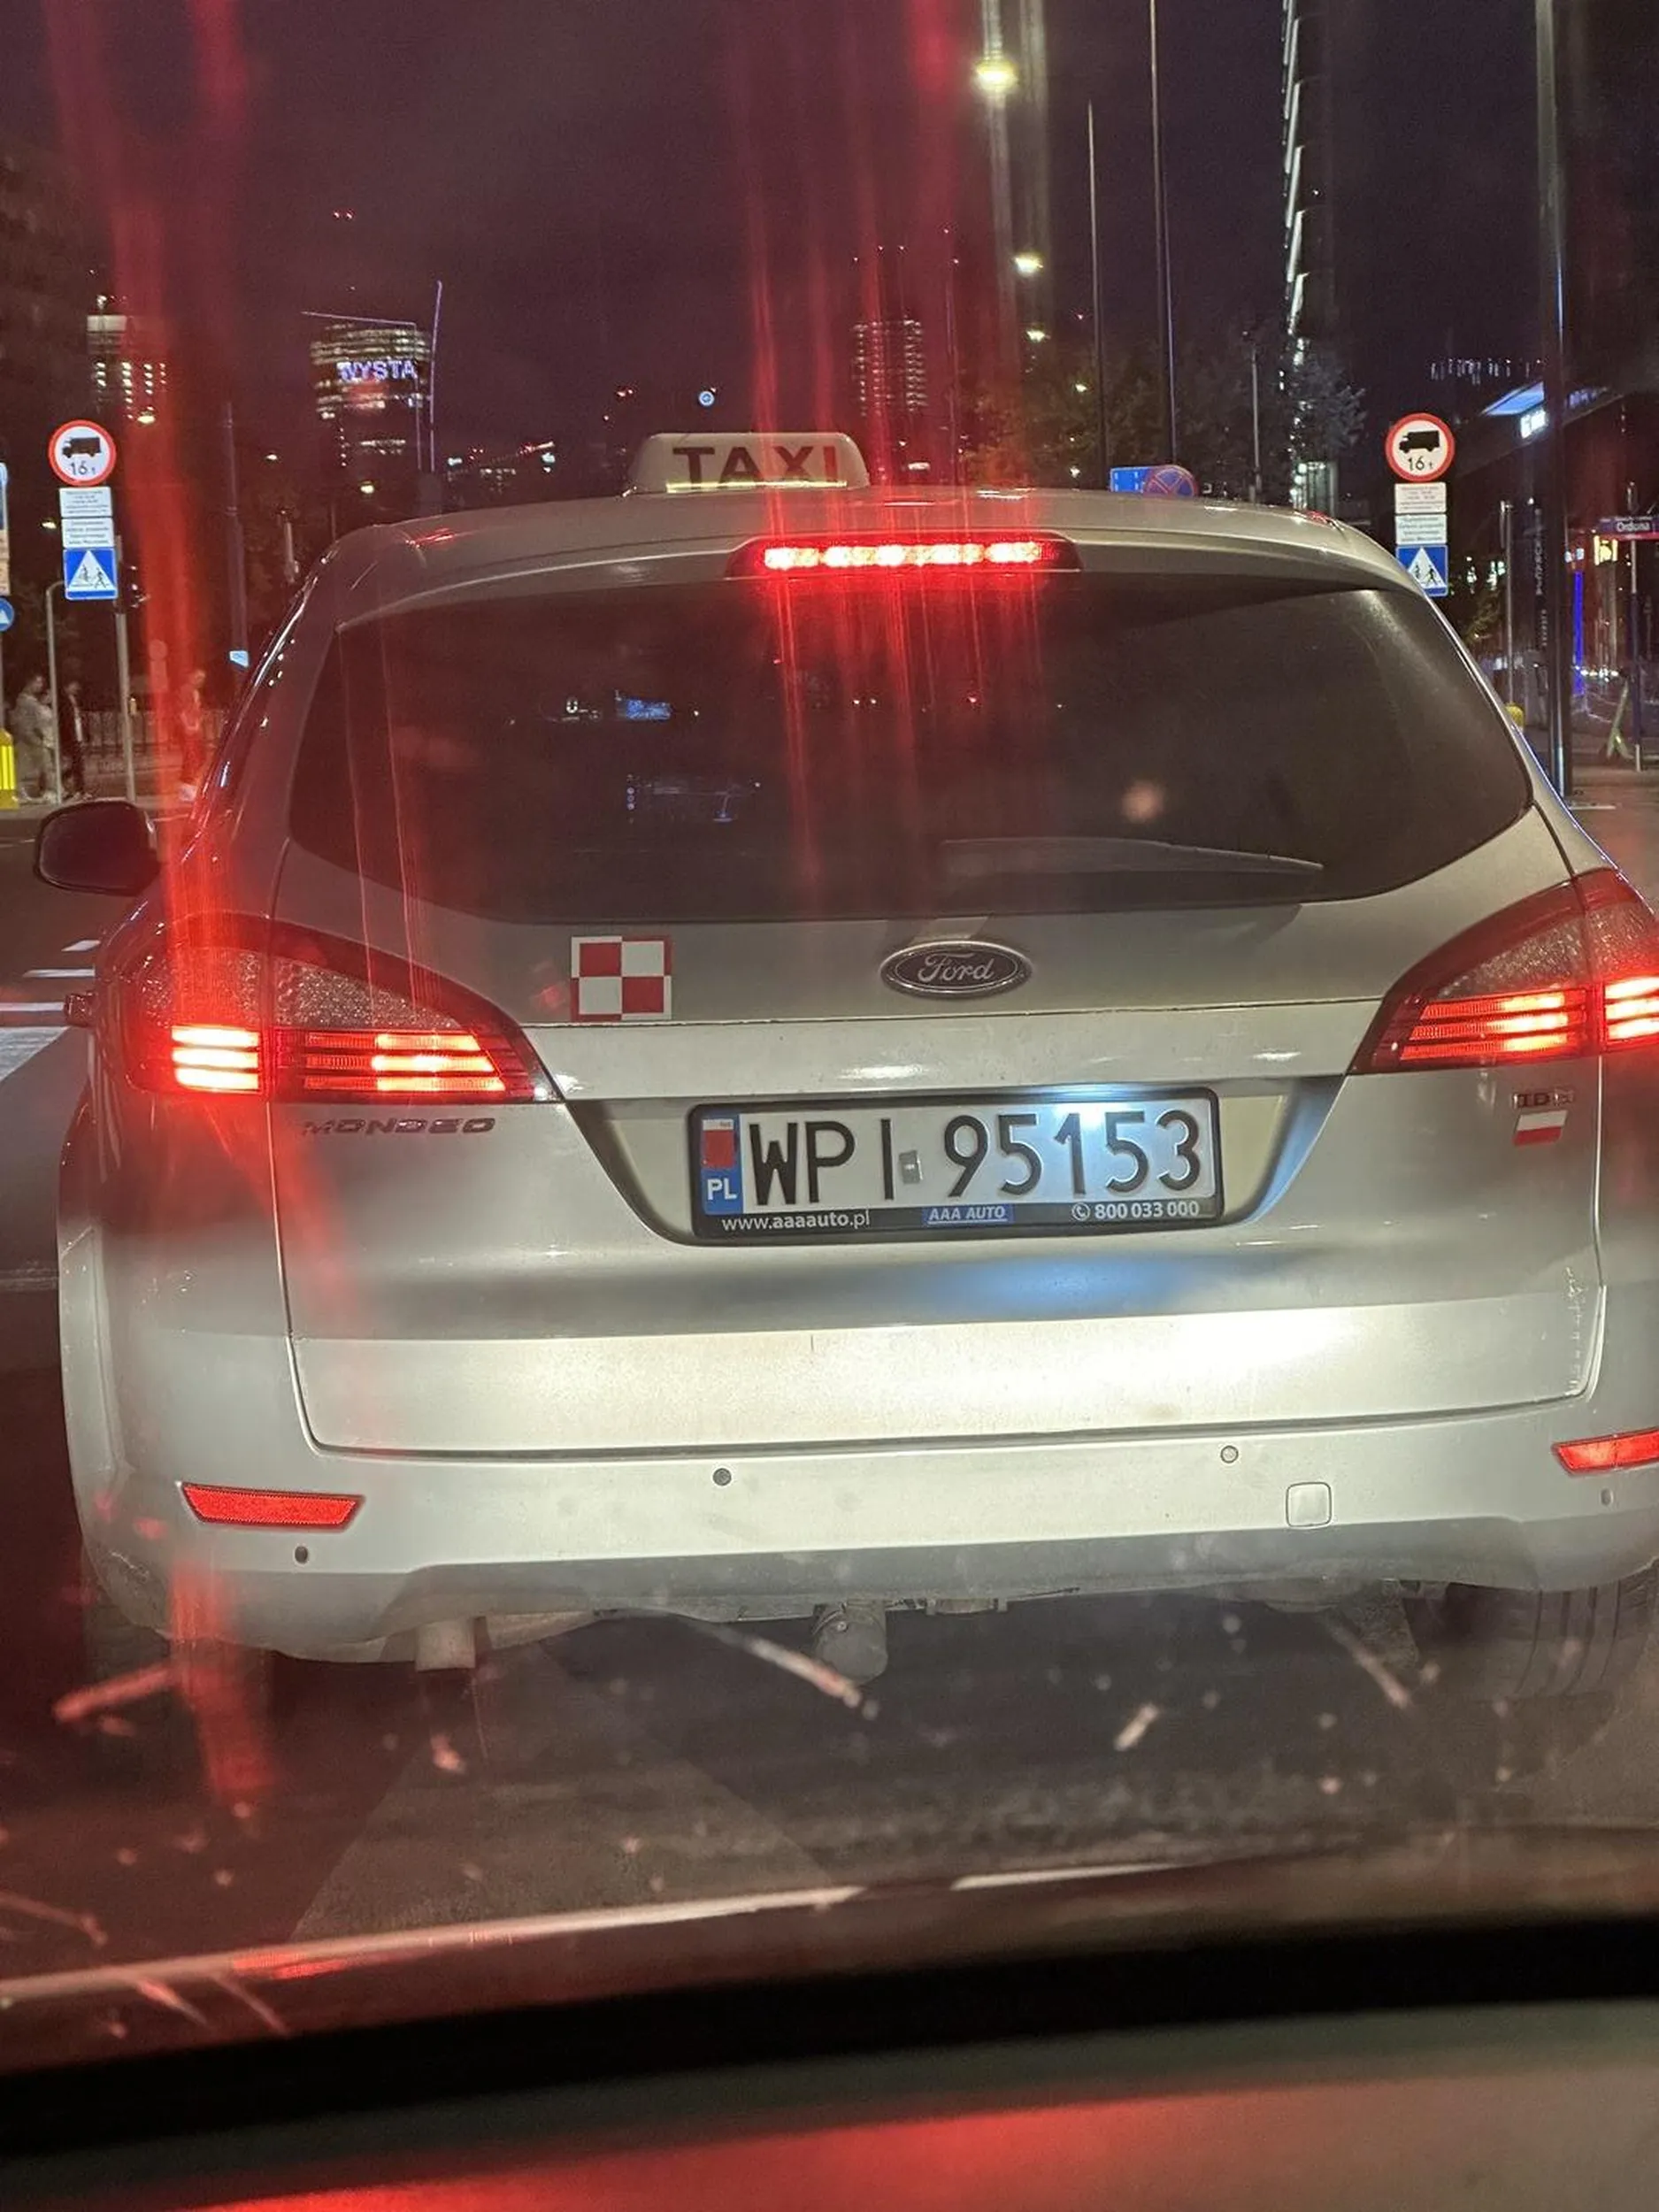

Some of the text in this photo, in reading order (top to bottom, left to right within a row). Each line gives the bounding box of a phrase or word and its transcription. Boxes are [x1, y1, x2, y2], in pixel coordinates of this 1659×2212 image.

[70, 460, 88, 476] 16
[673, 446, 839, 489] TAXI
[1408, 456, 1425, 472] 16
[918, 952, 995, 982] Ford
[302, 1117, 496, 1135] MONDEO
[944, 1109, 1201, 1198] 95153
[707, 1177, 739, 1201] PL
[721, 1209, 871, 1232] www.aaaauto.pl
[928, 1205, 1006, 1221] AAA AUTO
[1094, 1201, 1201, 1220] 800 033 000
